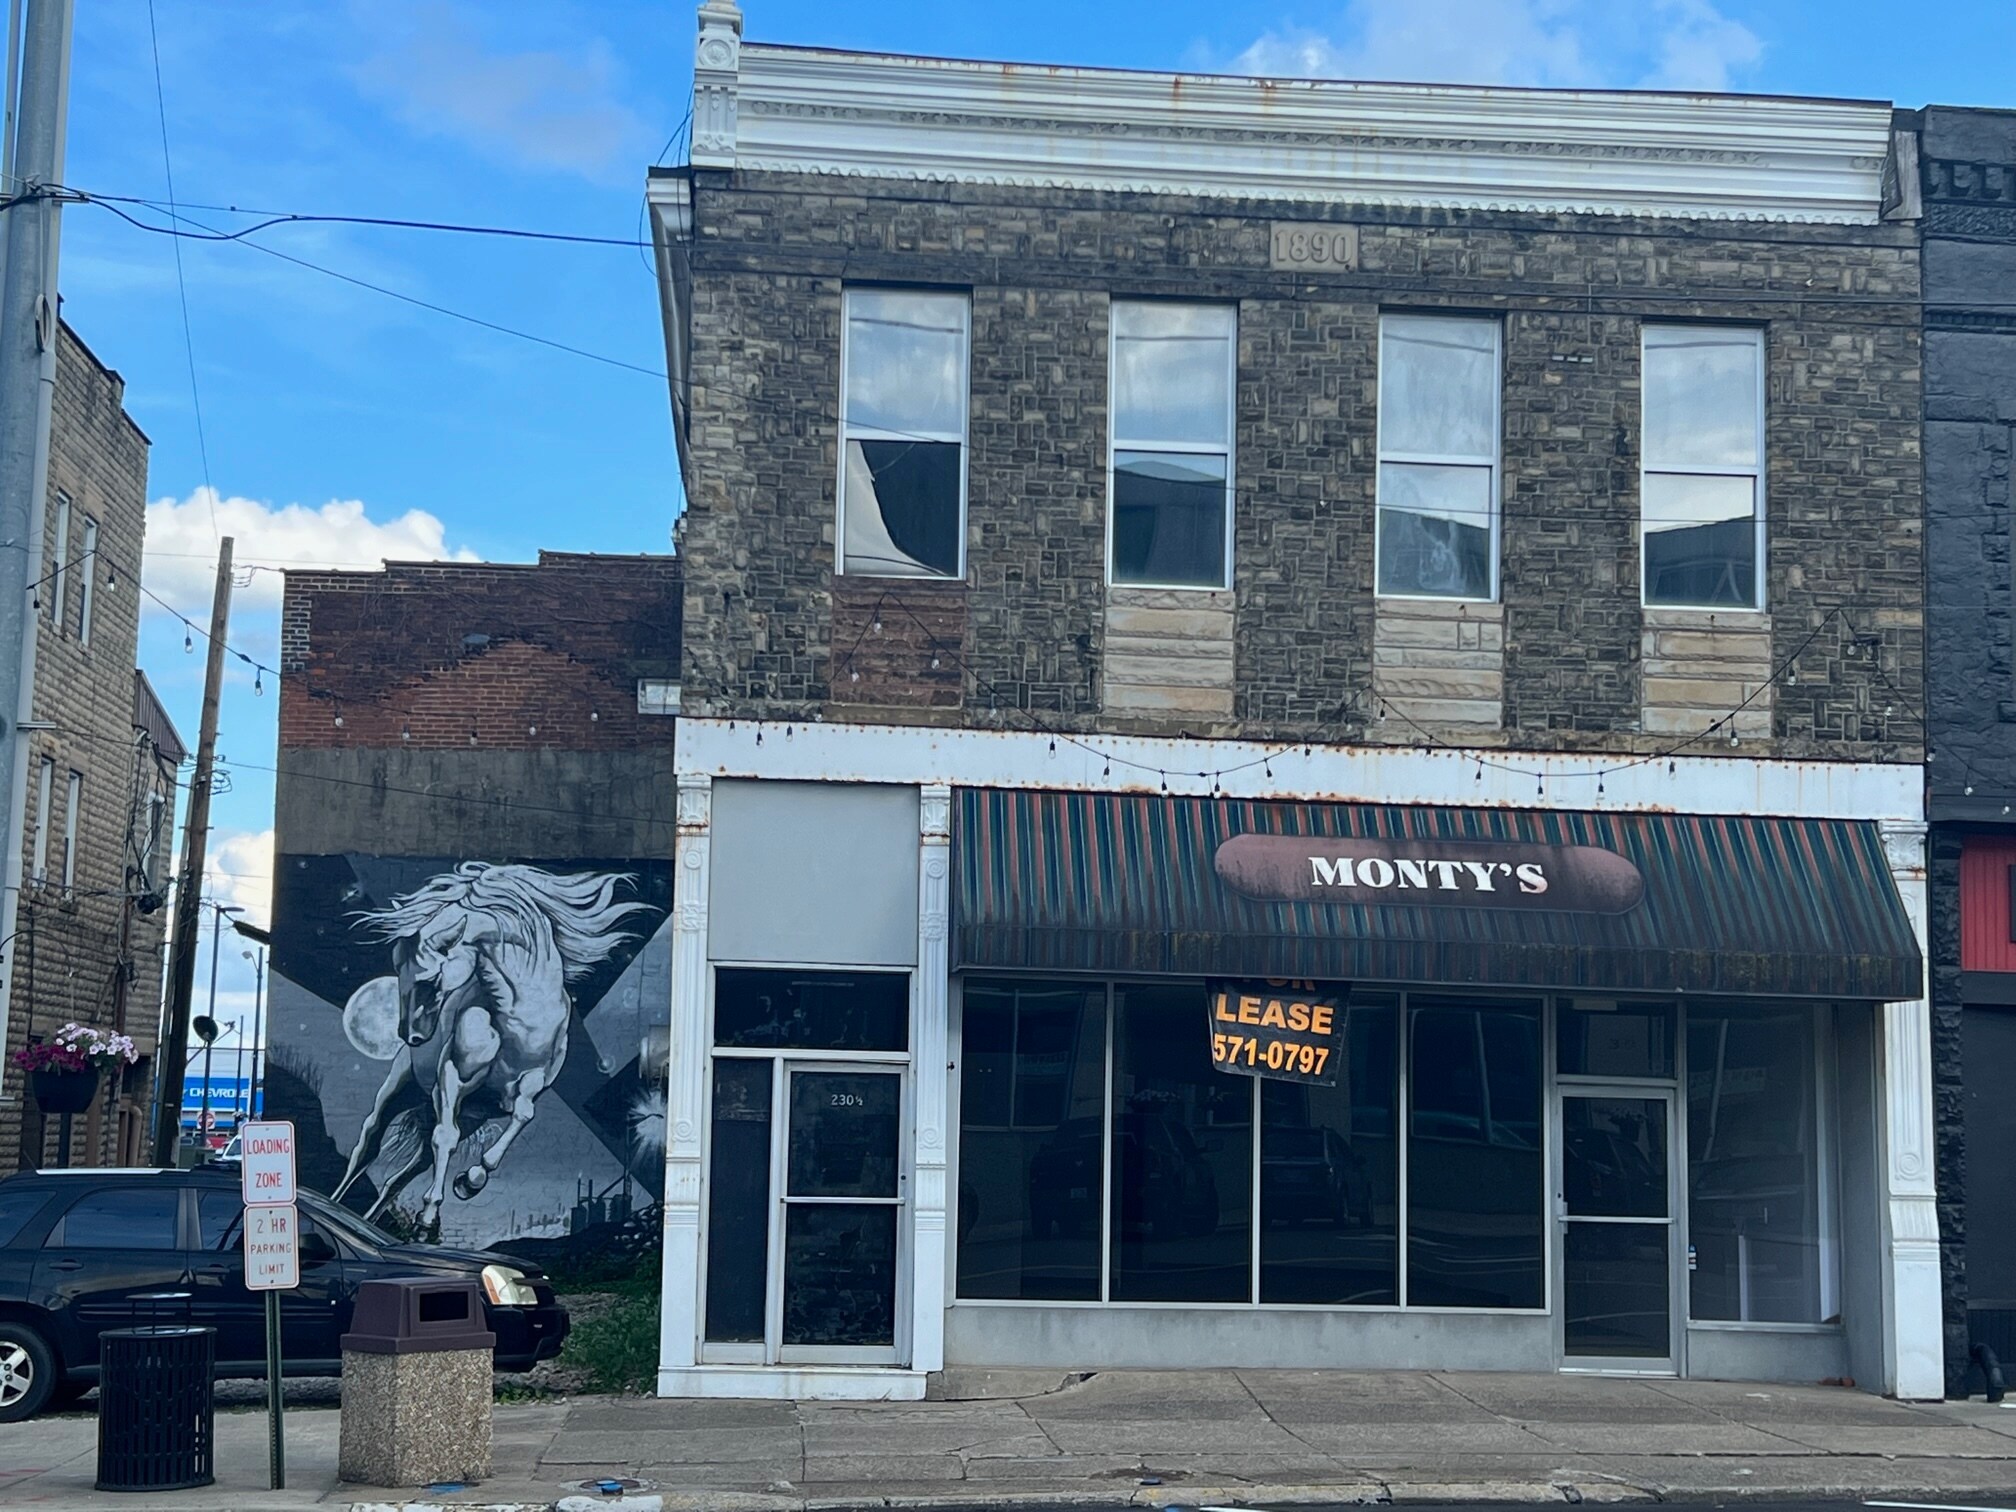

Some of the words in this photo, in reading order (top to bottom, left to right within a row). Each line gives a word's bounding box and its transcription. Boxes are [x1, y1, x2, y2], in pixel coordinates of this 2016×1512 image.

[1275, 230, 1352, 264] 1890
[1308, 856, 1549, 894] MONTY'S
[1215, 993, 1334, 1035] LEASE
[1213, 1033, 1330, 1076] 571-0797
[246, 1138, 291, 1155] LOADING
[255, 1172, 283, 1188] ZONE
[256, 1219, 265, 1234] 2
[271, 1218, 287, 1234] HR
[250, 1243, 292, 1255] PARKING
[258, 1263, 285, 1276] LIMIT
